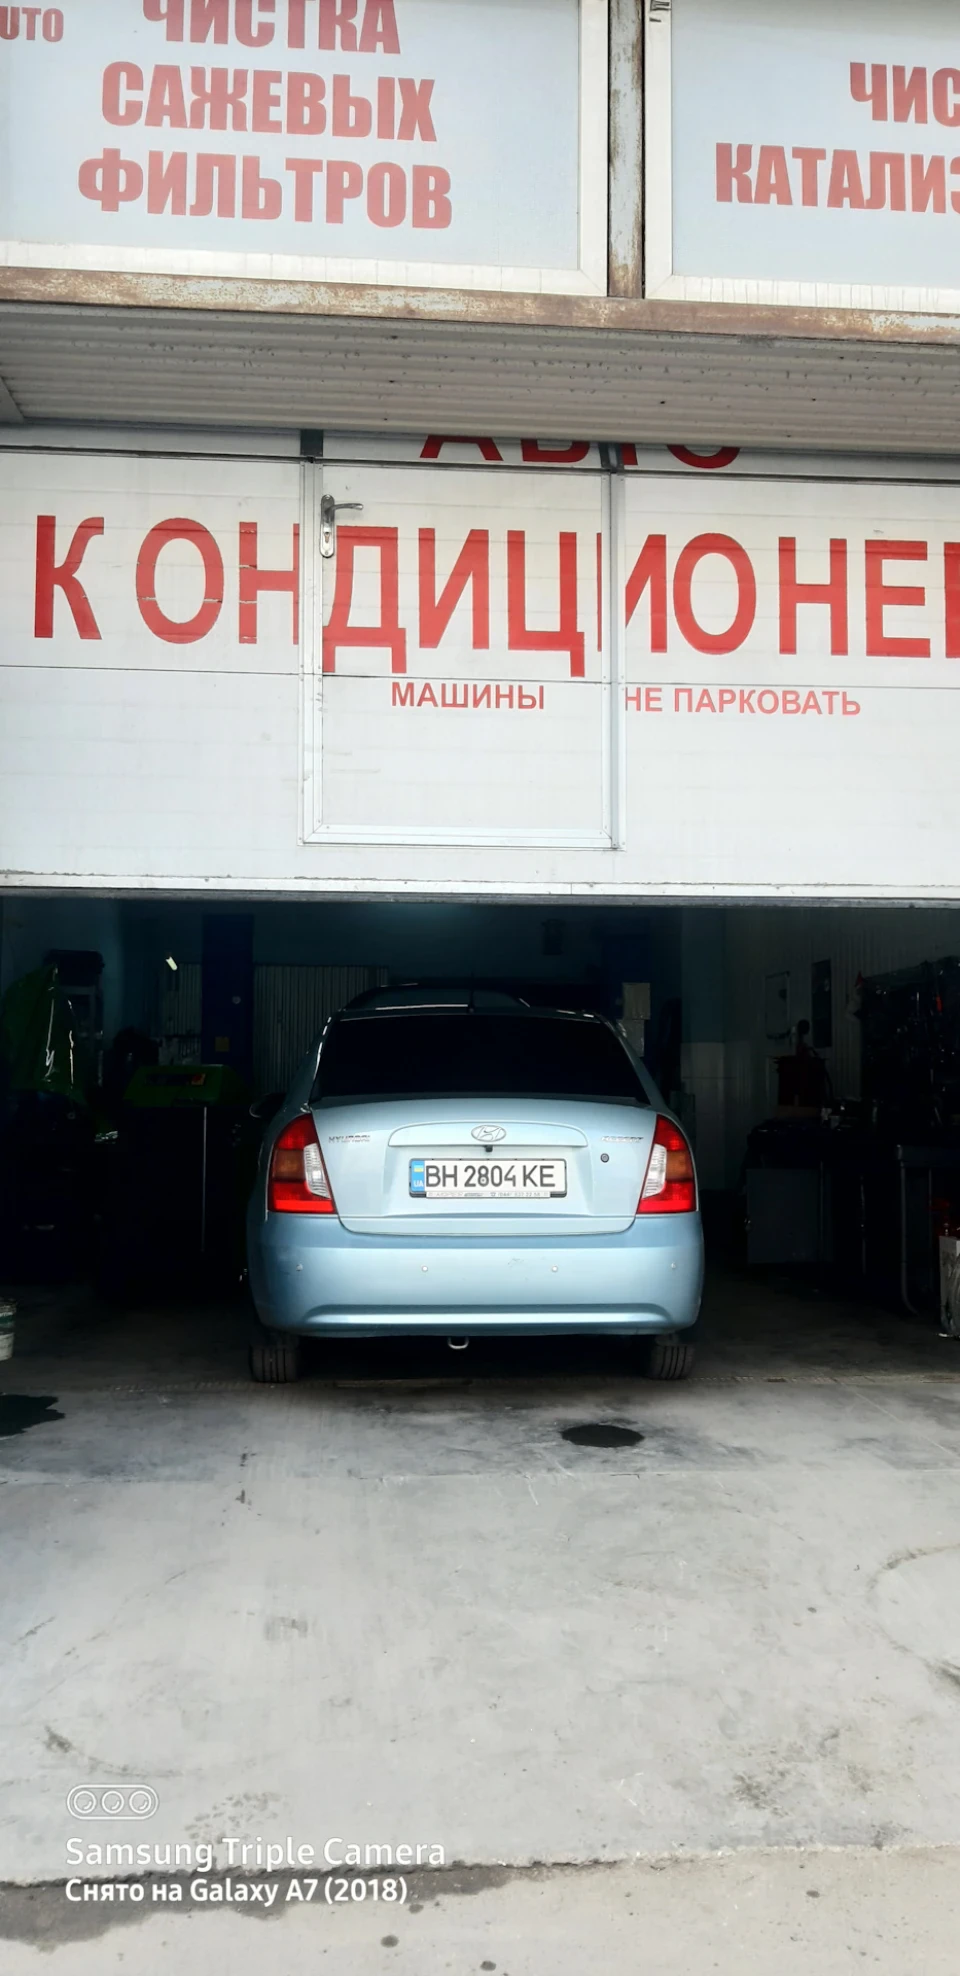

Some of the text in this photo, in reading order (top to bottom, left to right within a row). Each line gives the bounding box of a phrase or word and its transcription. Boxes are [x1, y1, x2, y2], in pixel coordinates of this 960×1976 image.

[142, 0, 401, 54] ЧИСТКА
[101, 61, 437, 142] САЖЕВЫХ
[849, 61, 960, 127] ЧИС
[78, 147, 453, 229] ФИЛЬТРОВ
[391, 681, 861, 716] МАШИНЫ НЕ ПАРКОВАТЬ
[413, 1180, 424, 1188] UA
[425, 1164, 556, 1188] BH 2804 KE
